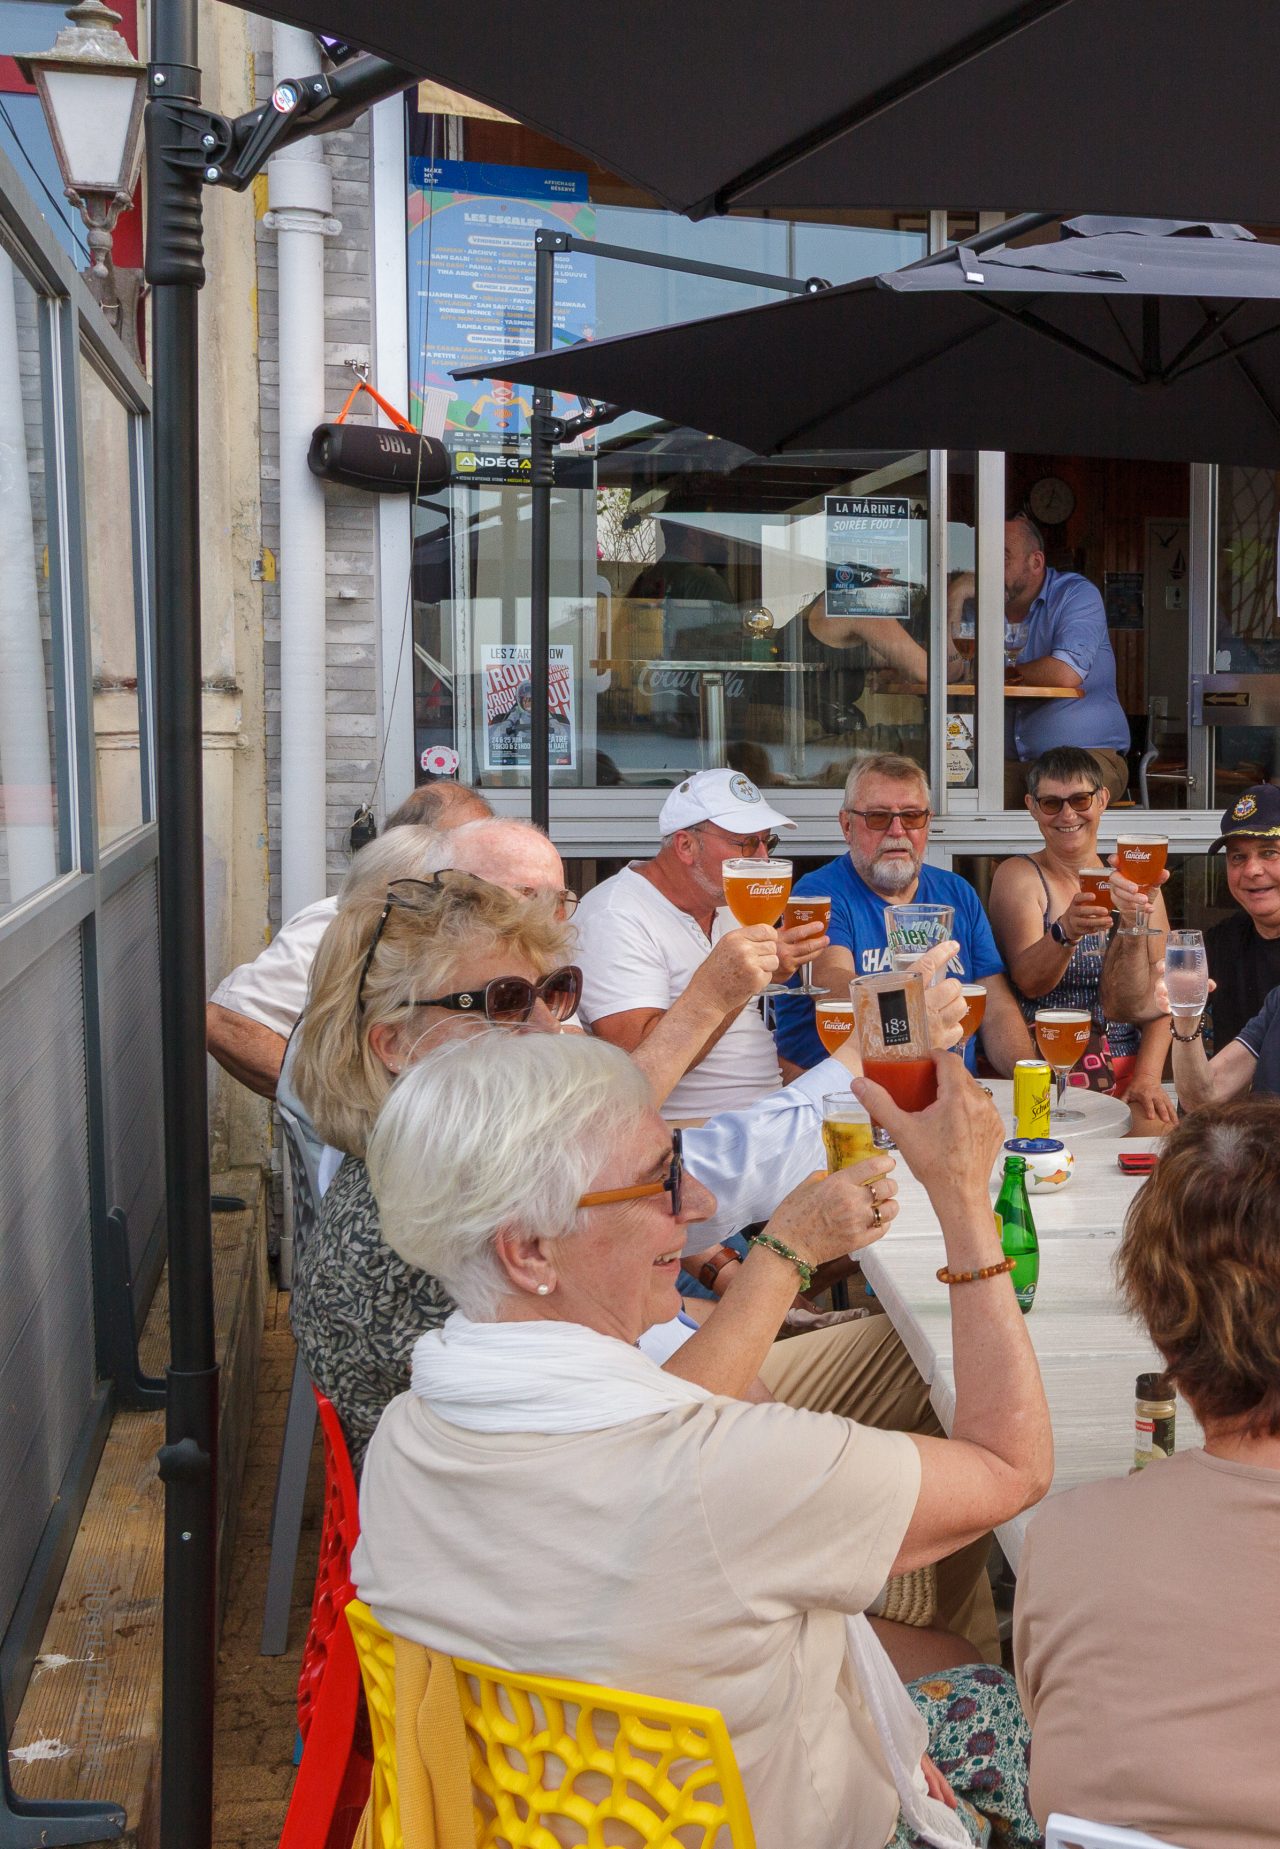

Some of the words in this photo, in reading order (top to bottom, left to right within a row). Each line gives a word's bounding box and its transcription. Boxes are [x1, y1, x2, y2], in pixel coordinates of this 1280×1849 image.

[550, 185, 576, 193] RÉSERVÉ
[464, 213, 487, 223] LES
[488, 214, 543, 227] ESCALES
[380, 433, 411, 455] JBL
[836, 503, 849, 513] LA
[852, 503, 896, 515] MARINE
[832, 519, 867, 532] SOIRÉE
[870, 519, 894, 530] FOOT
[860, 572, 873, 583] VS
[491, 648, 507, 659] LES
[1124, 850, 1151, 860] Lancelot
[746, 883, 785, 895] Lancelot
[823, 1020, 852, 1030] Lancelot
